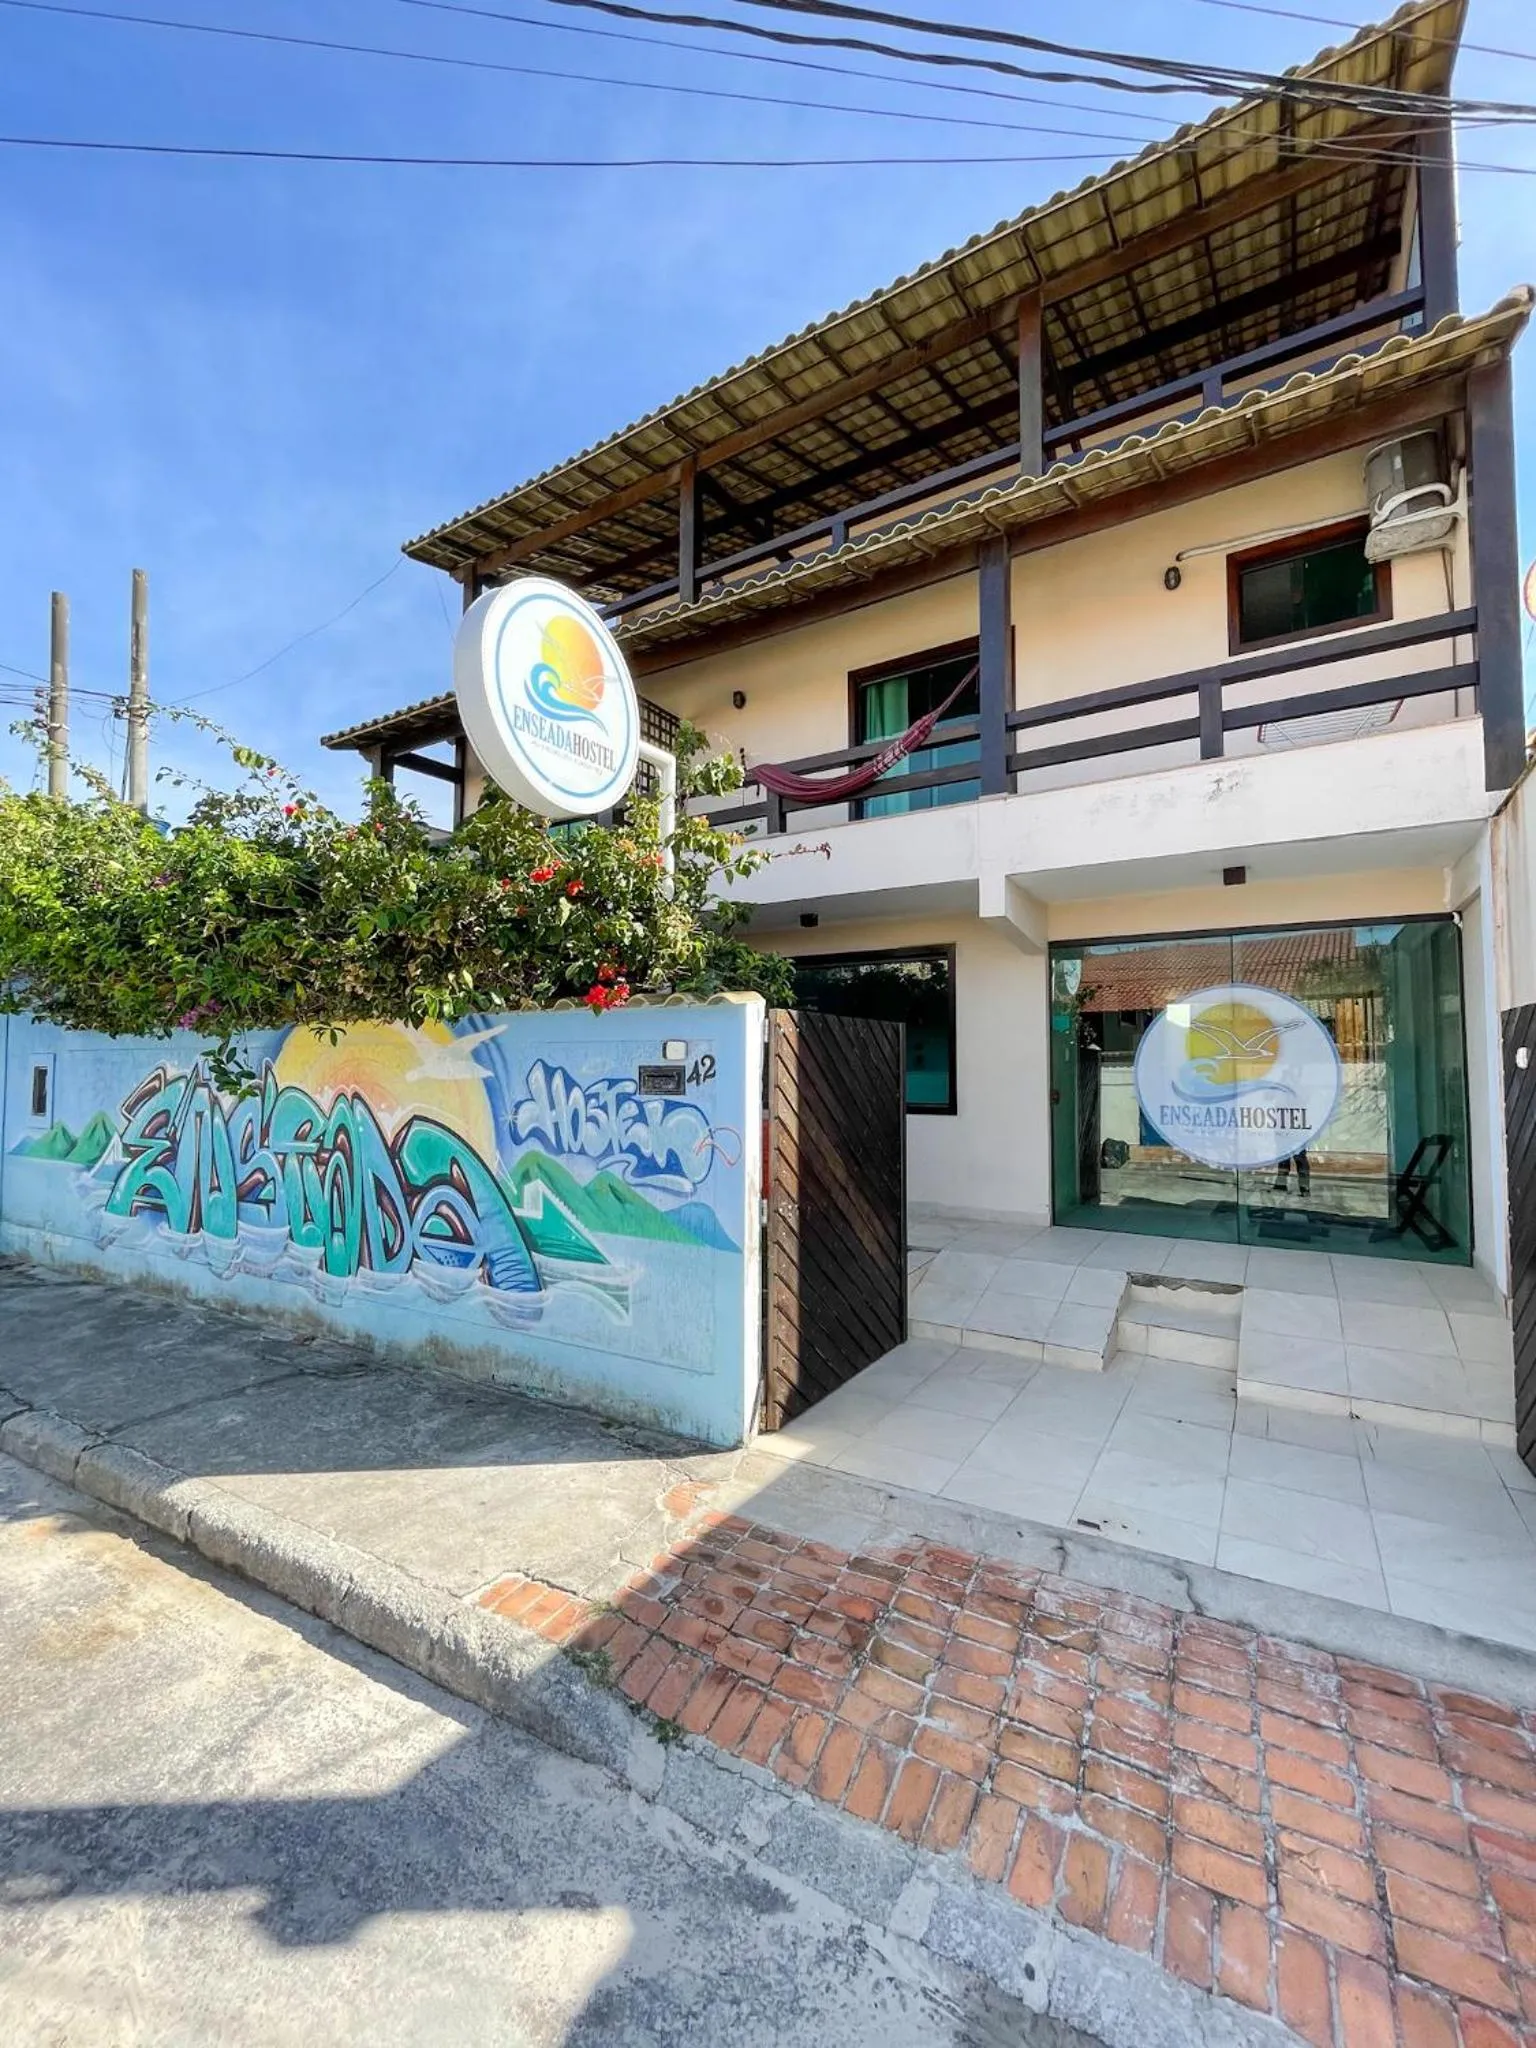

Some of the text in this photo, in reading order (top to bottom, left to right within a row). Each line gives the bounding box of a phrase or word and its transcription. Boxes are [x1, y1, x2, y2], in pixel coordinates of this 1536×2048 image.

[512, 703, 617, 773] ENSEADAHOSTEL
[686, 1053, 717, 1088] 42
[1159, 1104, 1313, 1131] ENSEADAHOSTEL
